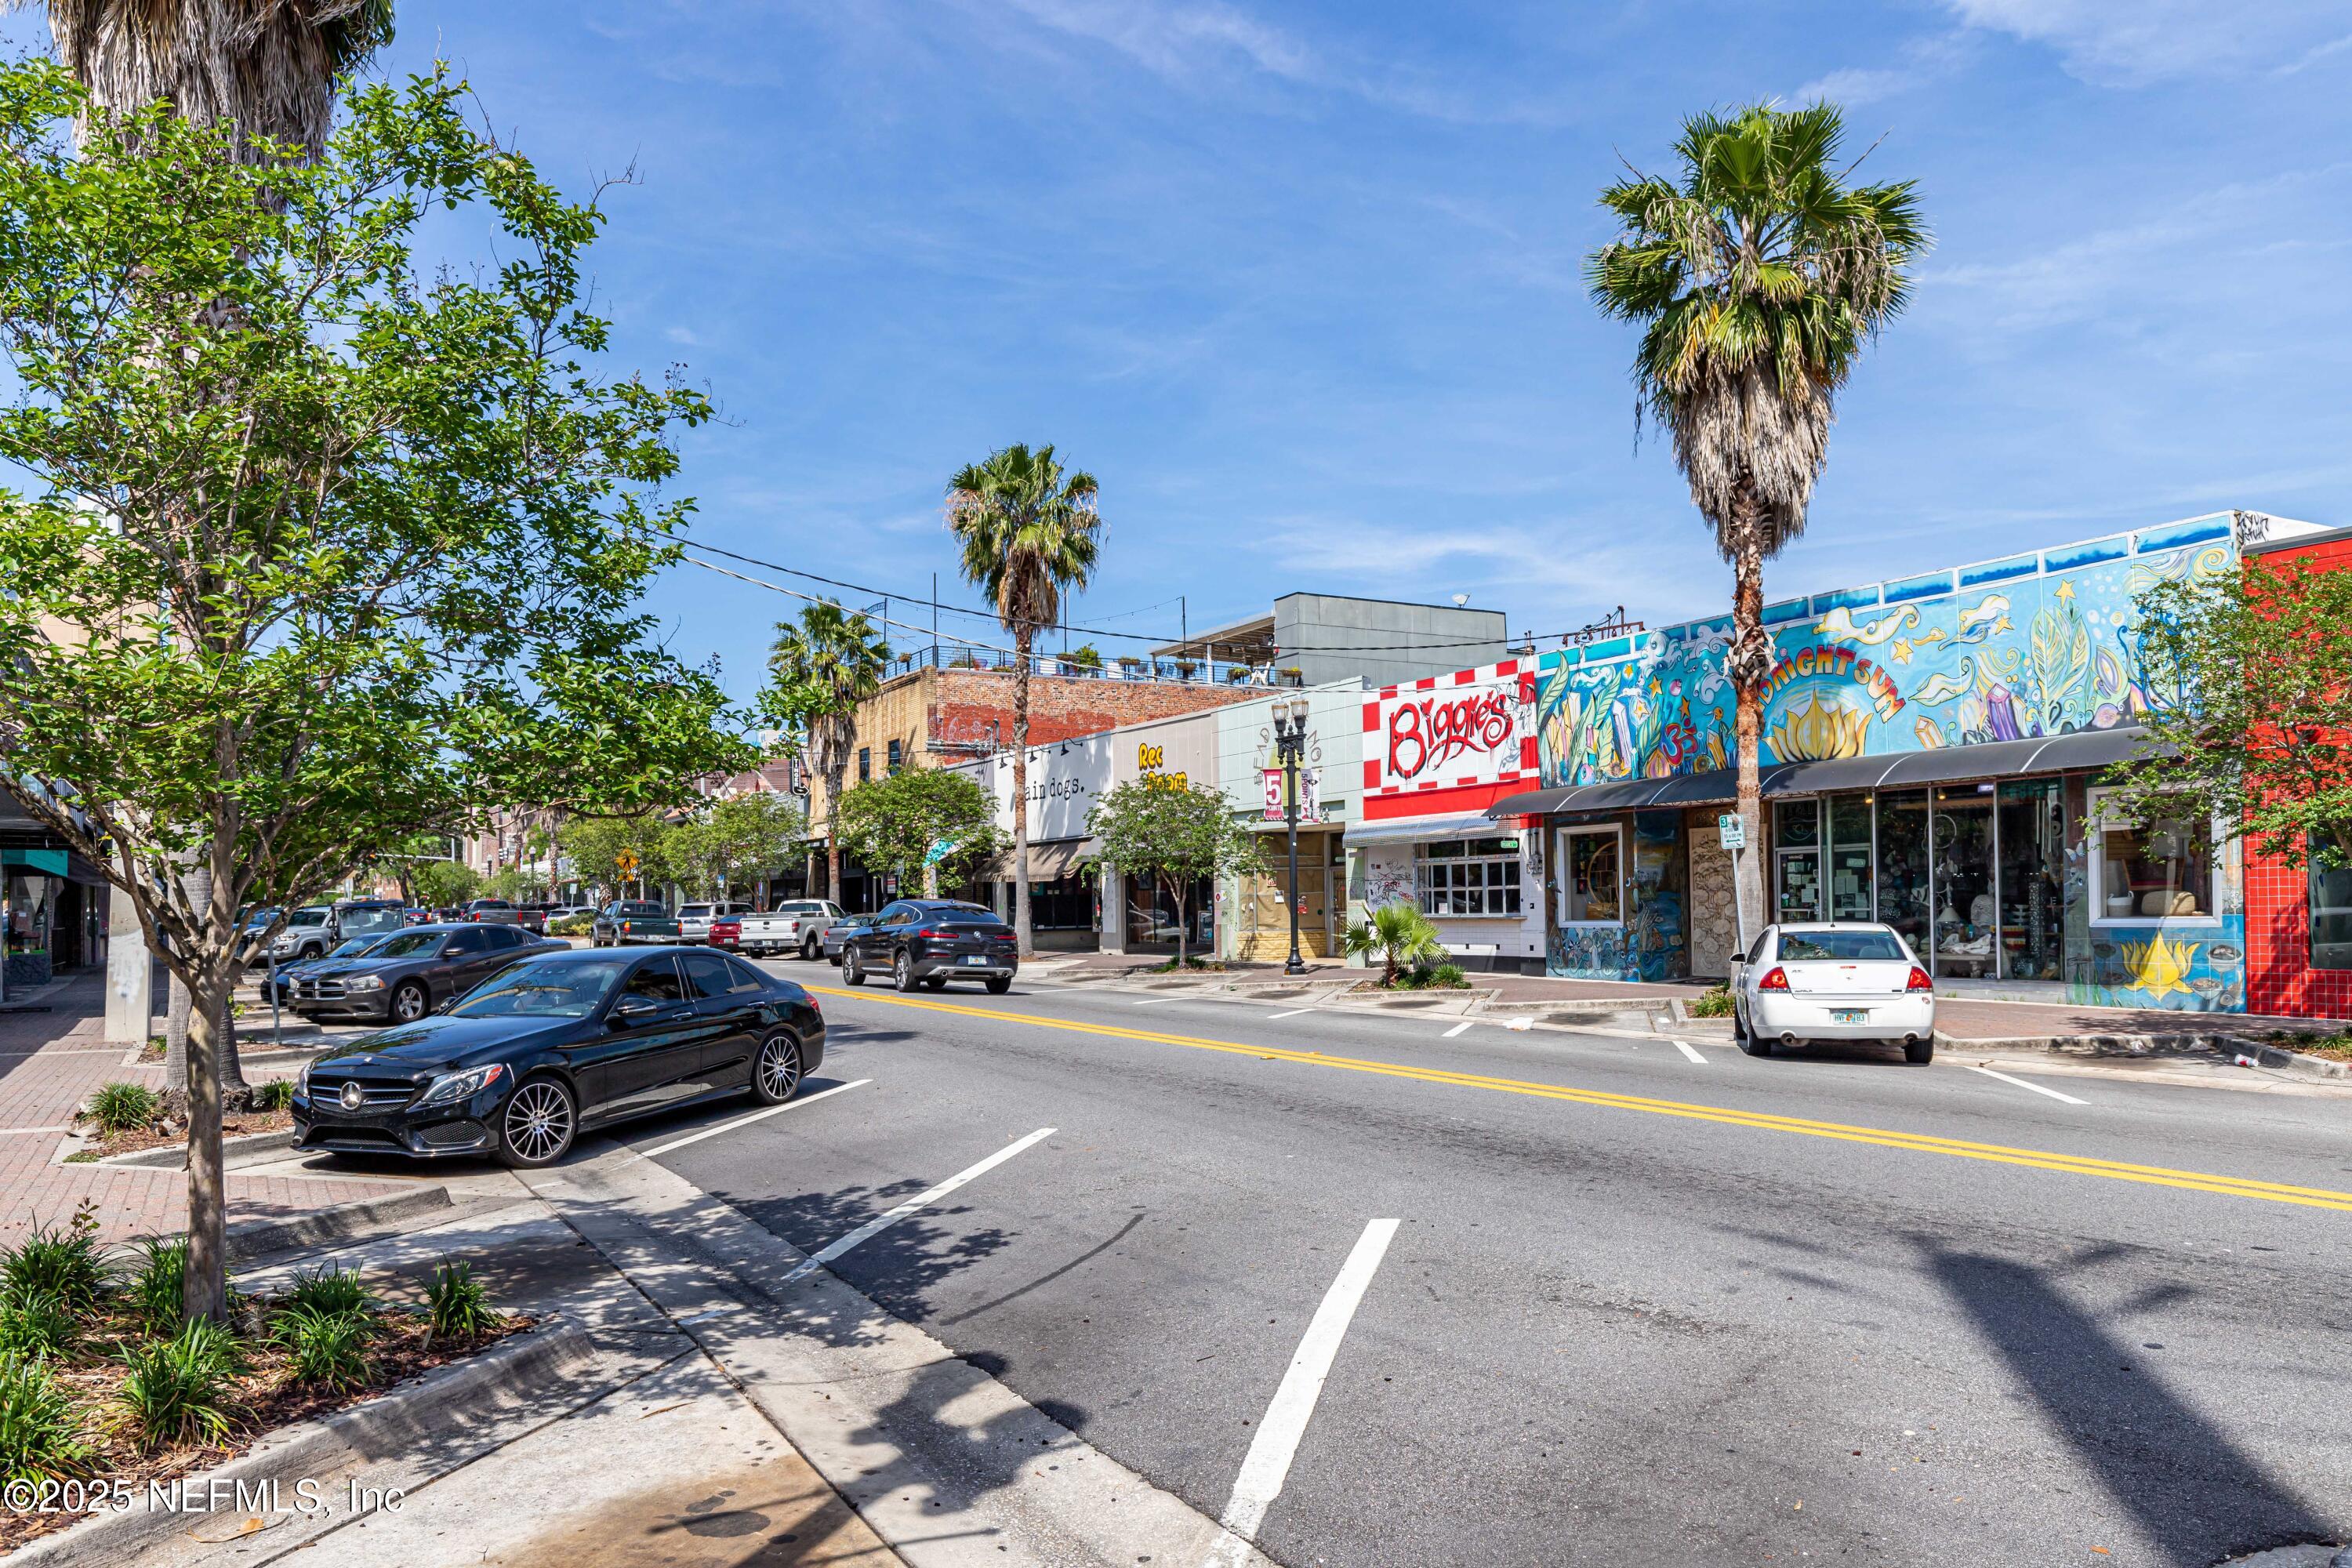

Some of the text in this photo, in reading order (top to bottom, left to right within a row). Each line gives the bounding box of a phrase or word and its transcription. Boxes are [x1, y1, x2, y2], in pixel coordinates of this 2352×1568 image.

[1853, 659, 1906, 724] SUN
[1138, 742, 1163, 771] Rec
[1025, 778, 1085, 800] ain dogs.
[1266, 775, 1281, 805] 5
[1721, 818, 1726, 826] 3
